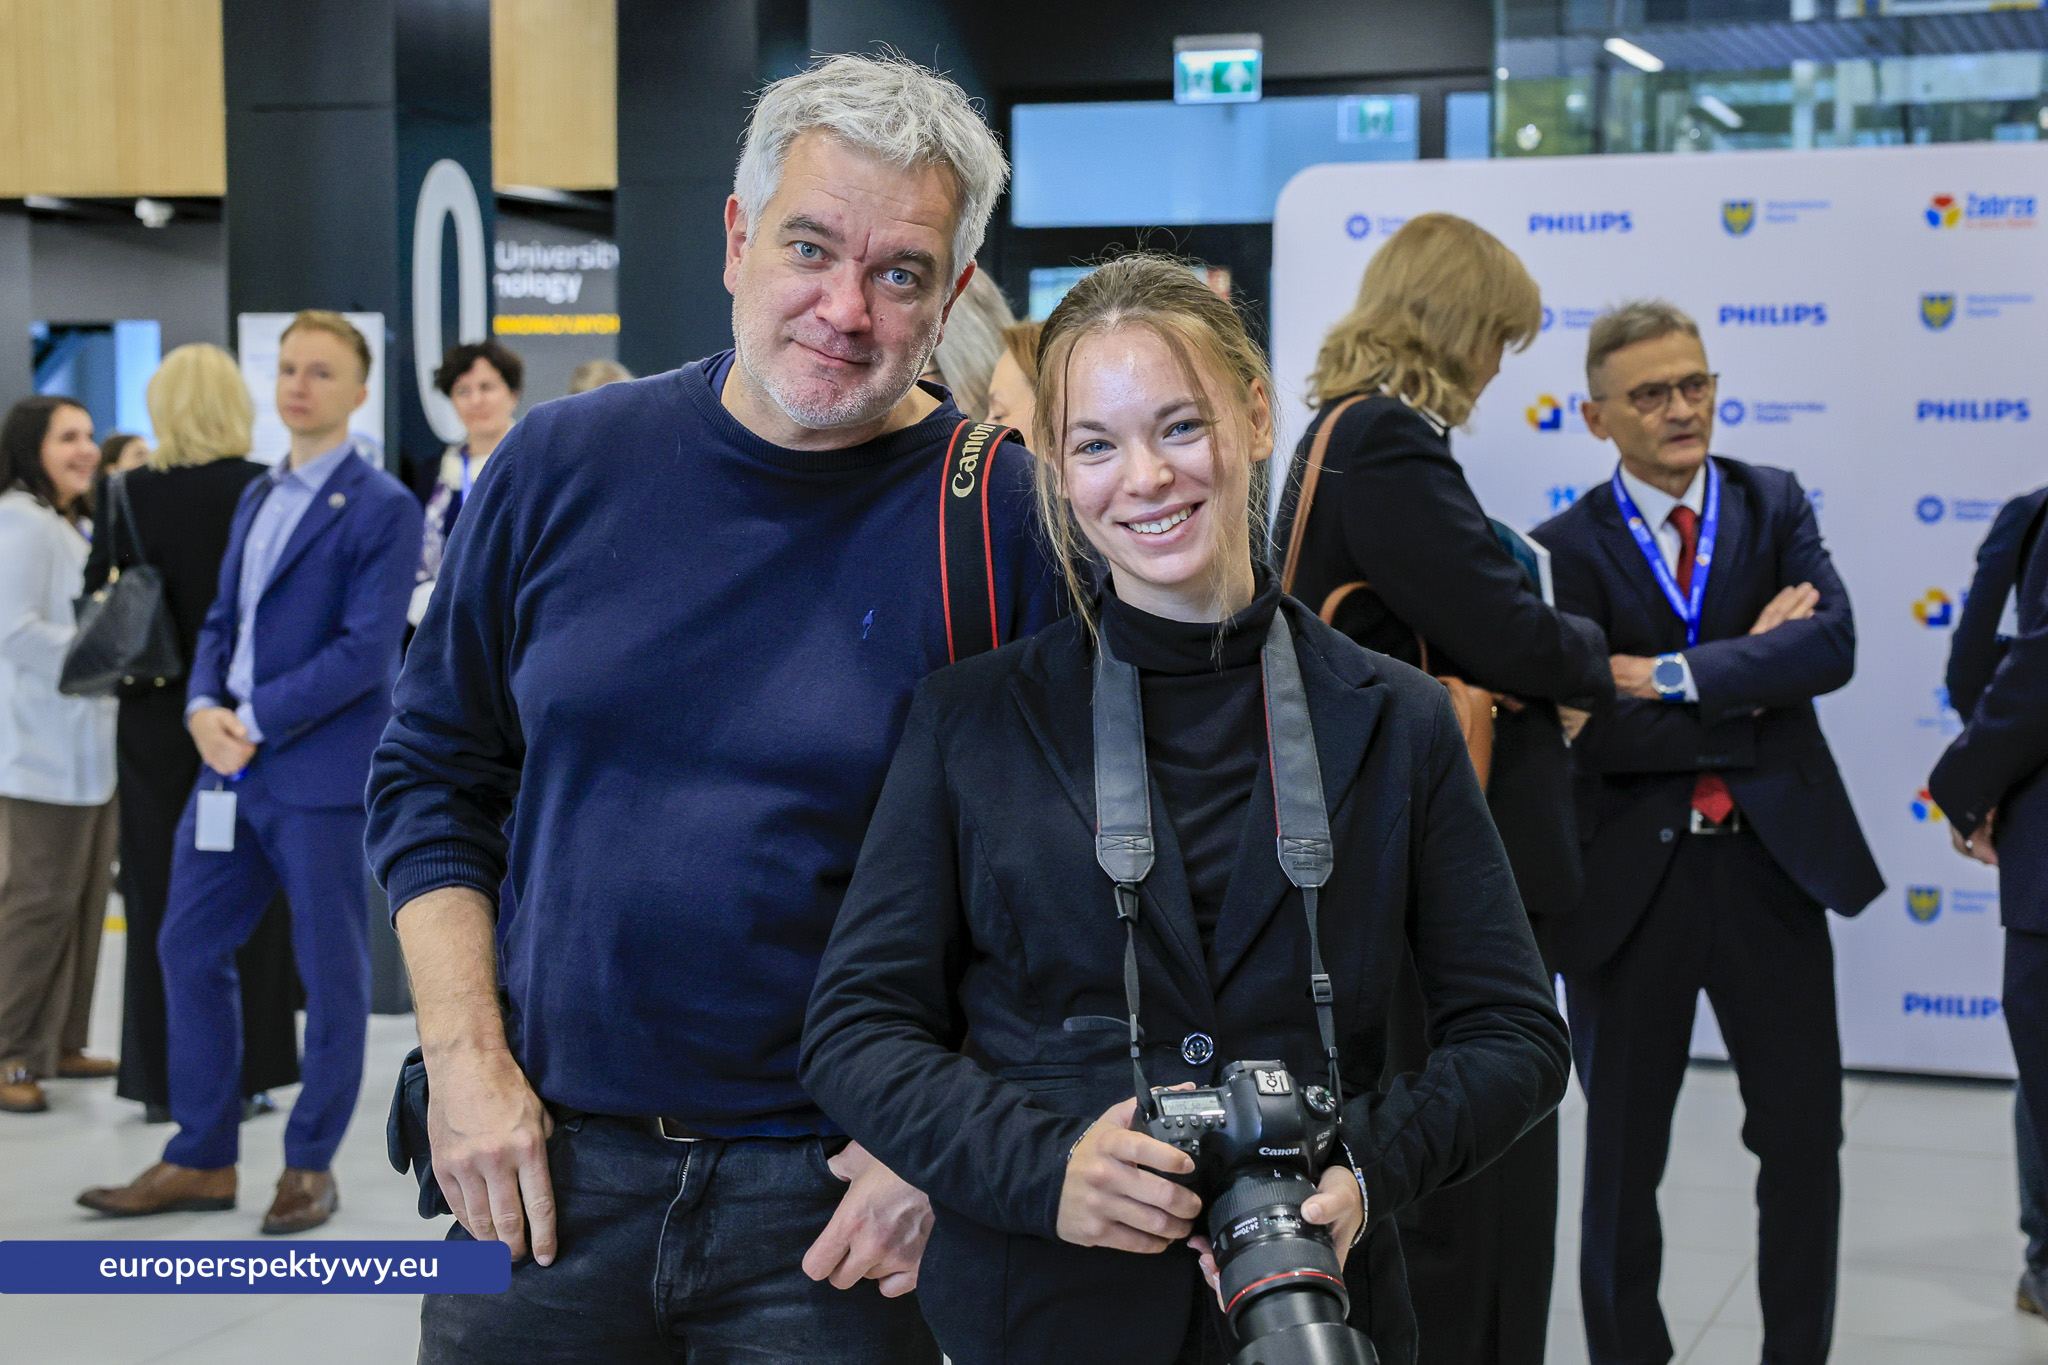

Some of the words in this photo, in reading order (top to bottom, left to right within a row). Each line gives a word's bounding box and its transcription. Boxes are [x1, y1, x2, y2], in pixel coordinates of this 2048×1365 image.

[1528, 211, 1633, 234] PHILIPS
[1718, 302, 1828, 327] PHILIPS
[1916, 398, 2031, 423] PHILIPS
[952, 423, 997, 498] Canon
[1903, 993, 2004, 1018] PHILIP
[1258, 1146, 1300, 1156] Canon
